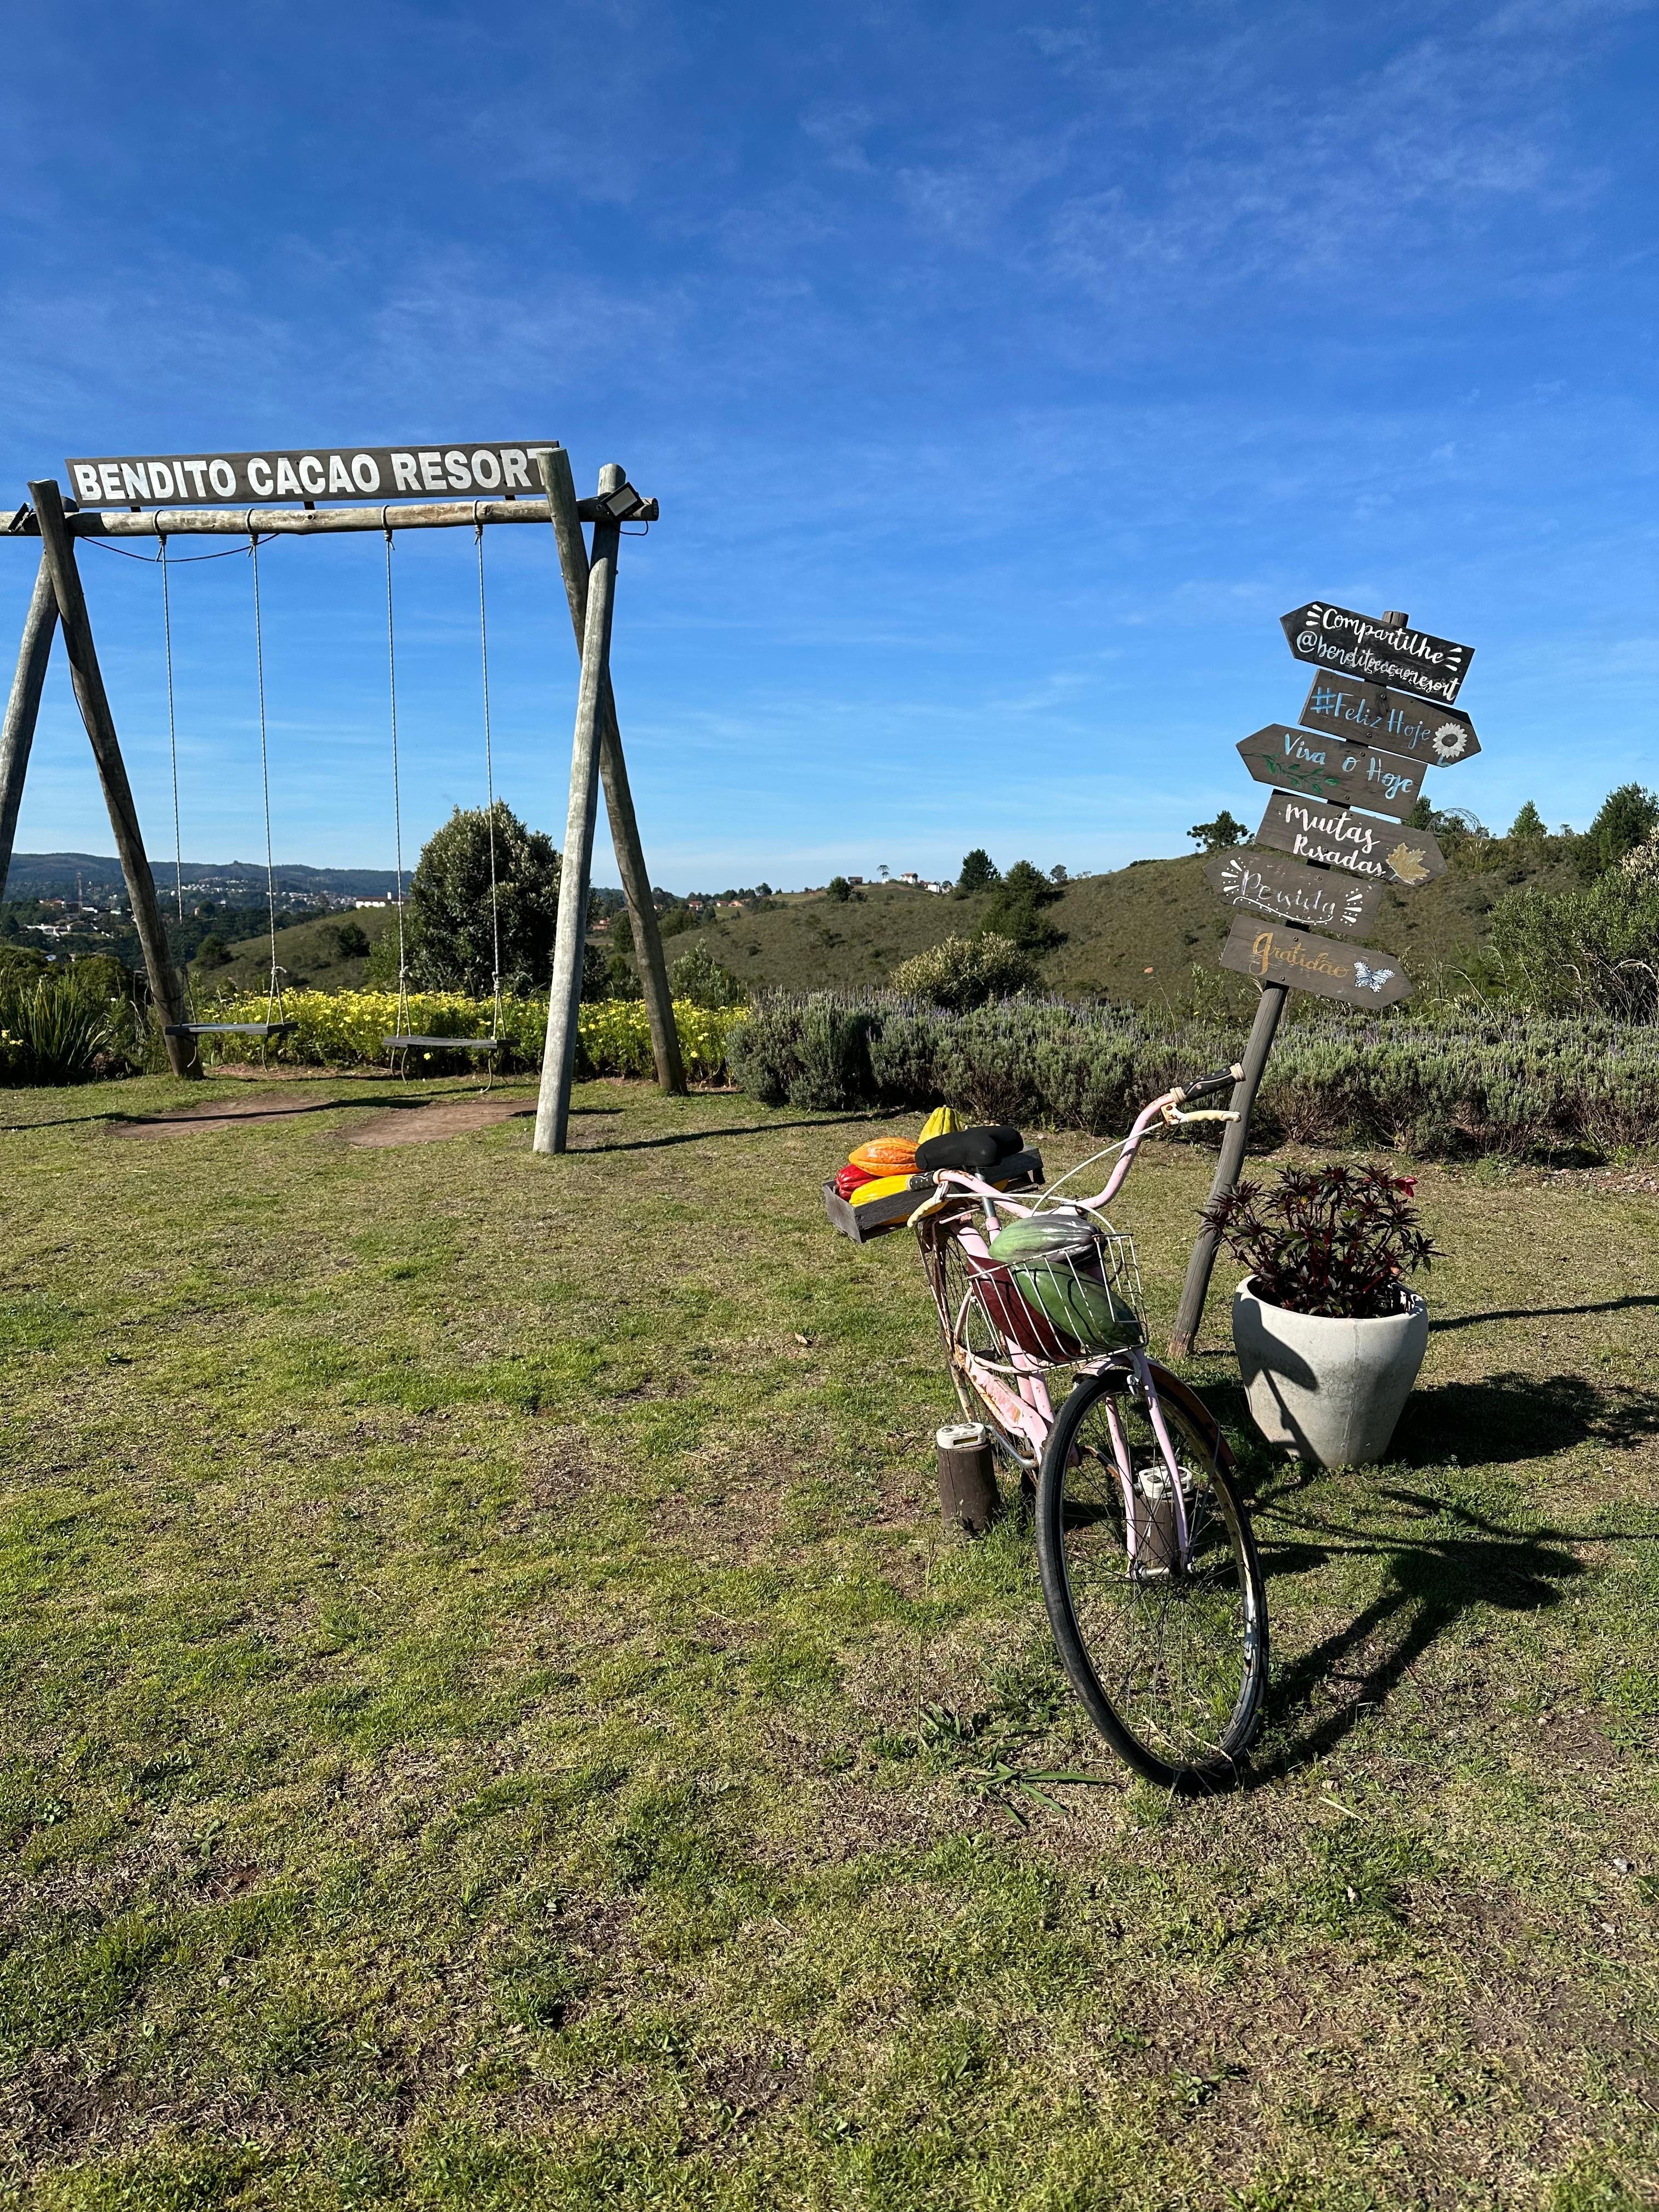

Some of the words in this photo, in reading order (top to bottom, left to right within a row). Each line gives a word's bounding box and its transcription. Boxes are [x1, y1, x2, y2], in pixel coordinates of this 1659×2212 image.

[74, 459, 236, 501] BENDITO
[247, 453, 381, 496] CACAO
[1322, 608, 1444, 664] Compartilhe
[1284, 733, 1326, 765] Viva
[1366, 757, 1414, 800] Hoje
[1285, 803, 1381, 854] Muitas
[1293, 833, 1387, 878] Risadas
